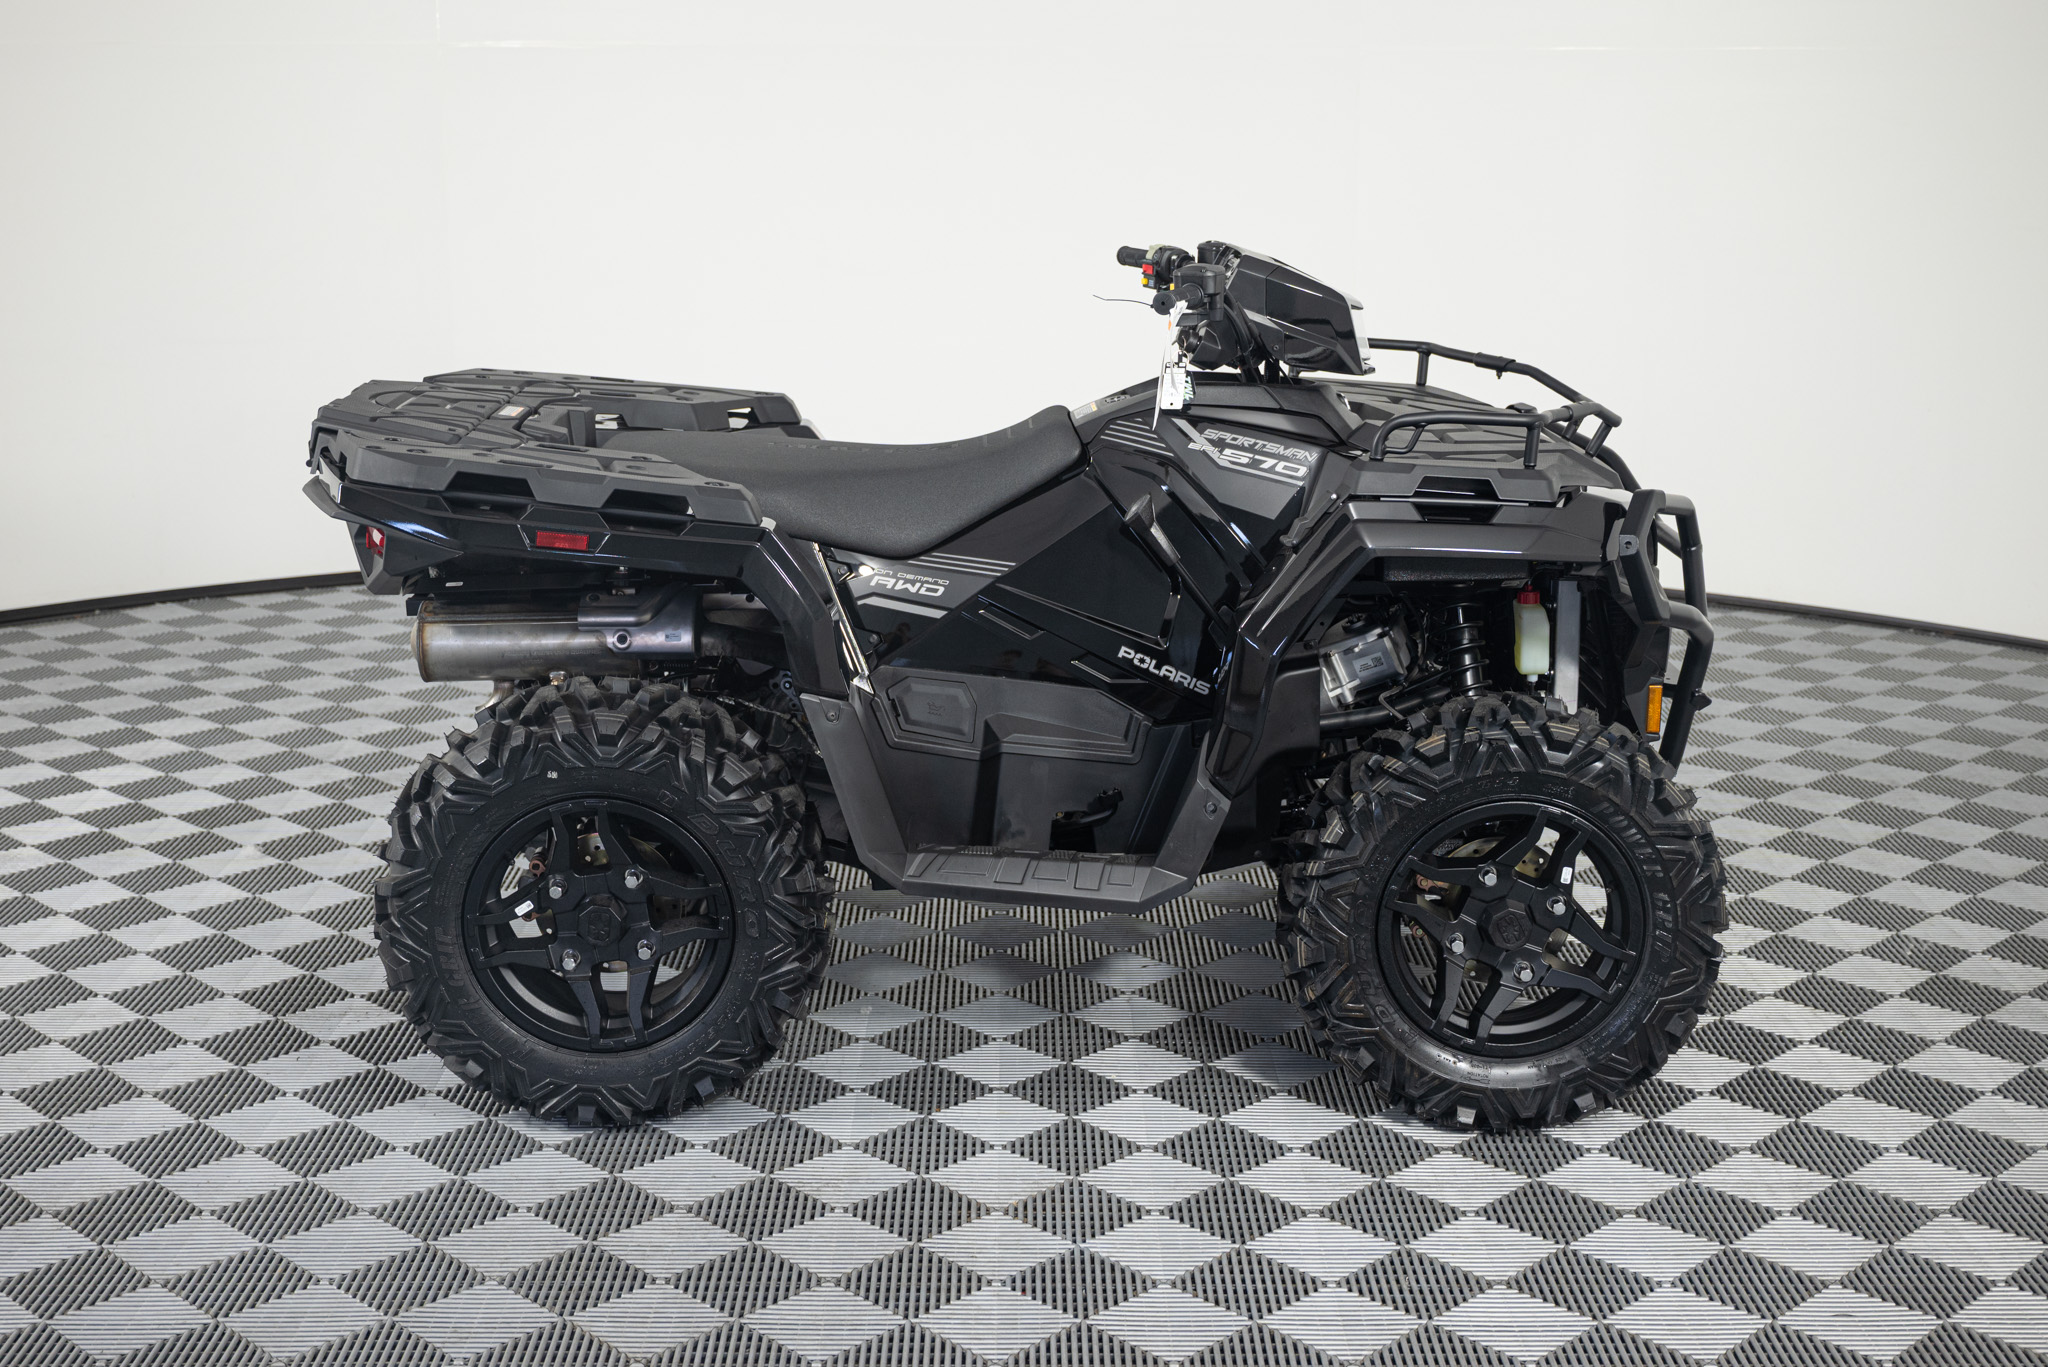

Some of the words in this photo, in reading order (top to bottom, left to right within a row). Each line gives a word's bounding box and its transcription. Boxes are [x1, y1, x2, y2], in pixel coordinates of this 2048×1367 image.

[1200, 428, 1320, 463] SPORTSMAN
[1219, 448, 1309, 478] 570
[869, 575, 945, 597] AWD
[874, 567, 893, 576] ON
[897, 572, 950, 586] DEMAND
[1117, 645, 1211, 696] POLARIS
[686, 811, 761, 940] DURO
[1589, 800, 1665, 879] POWER
[1652, 891, 1674, 964] GRIP
